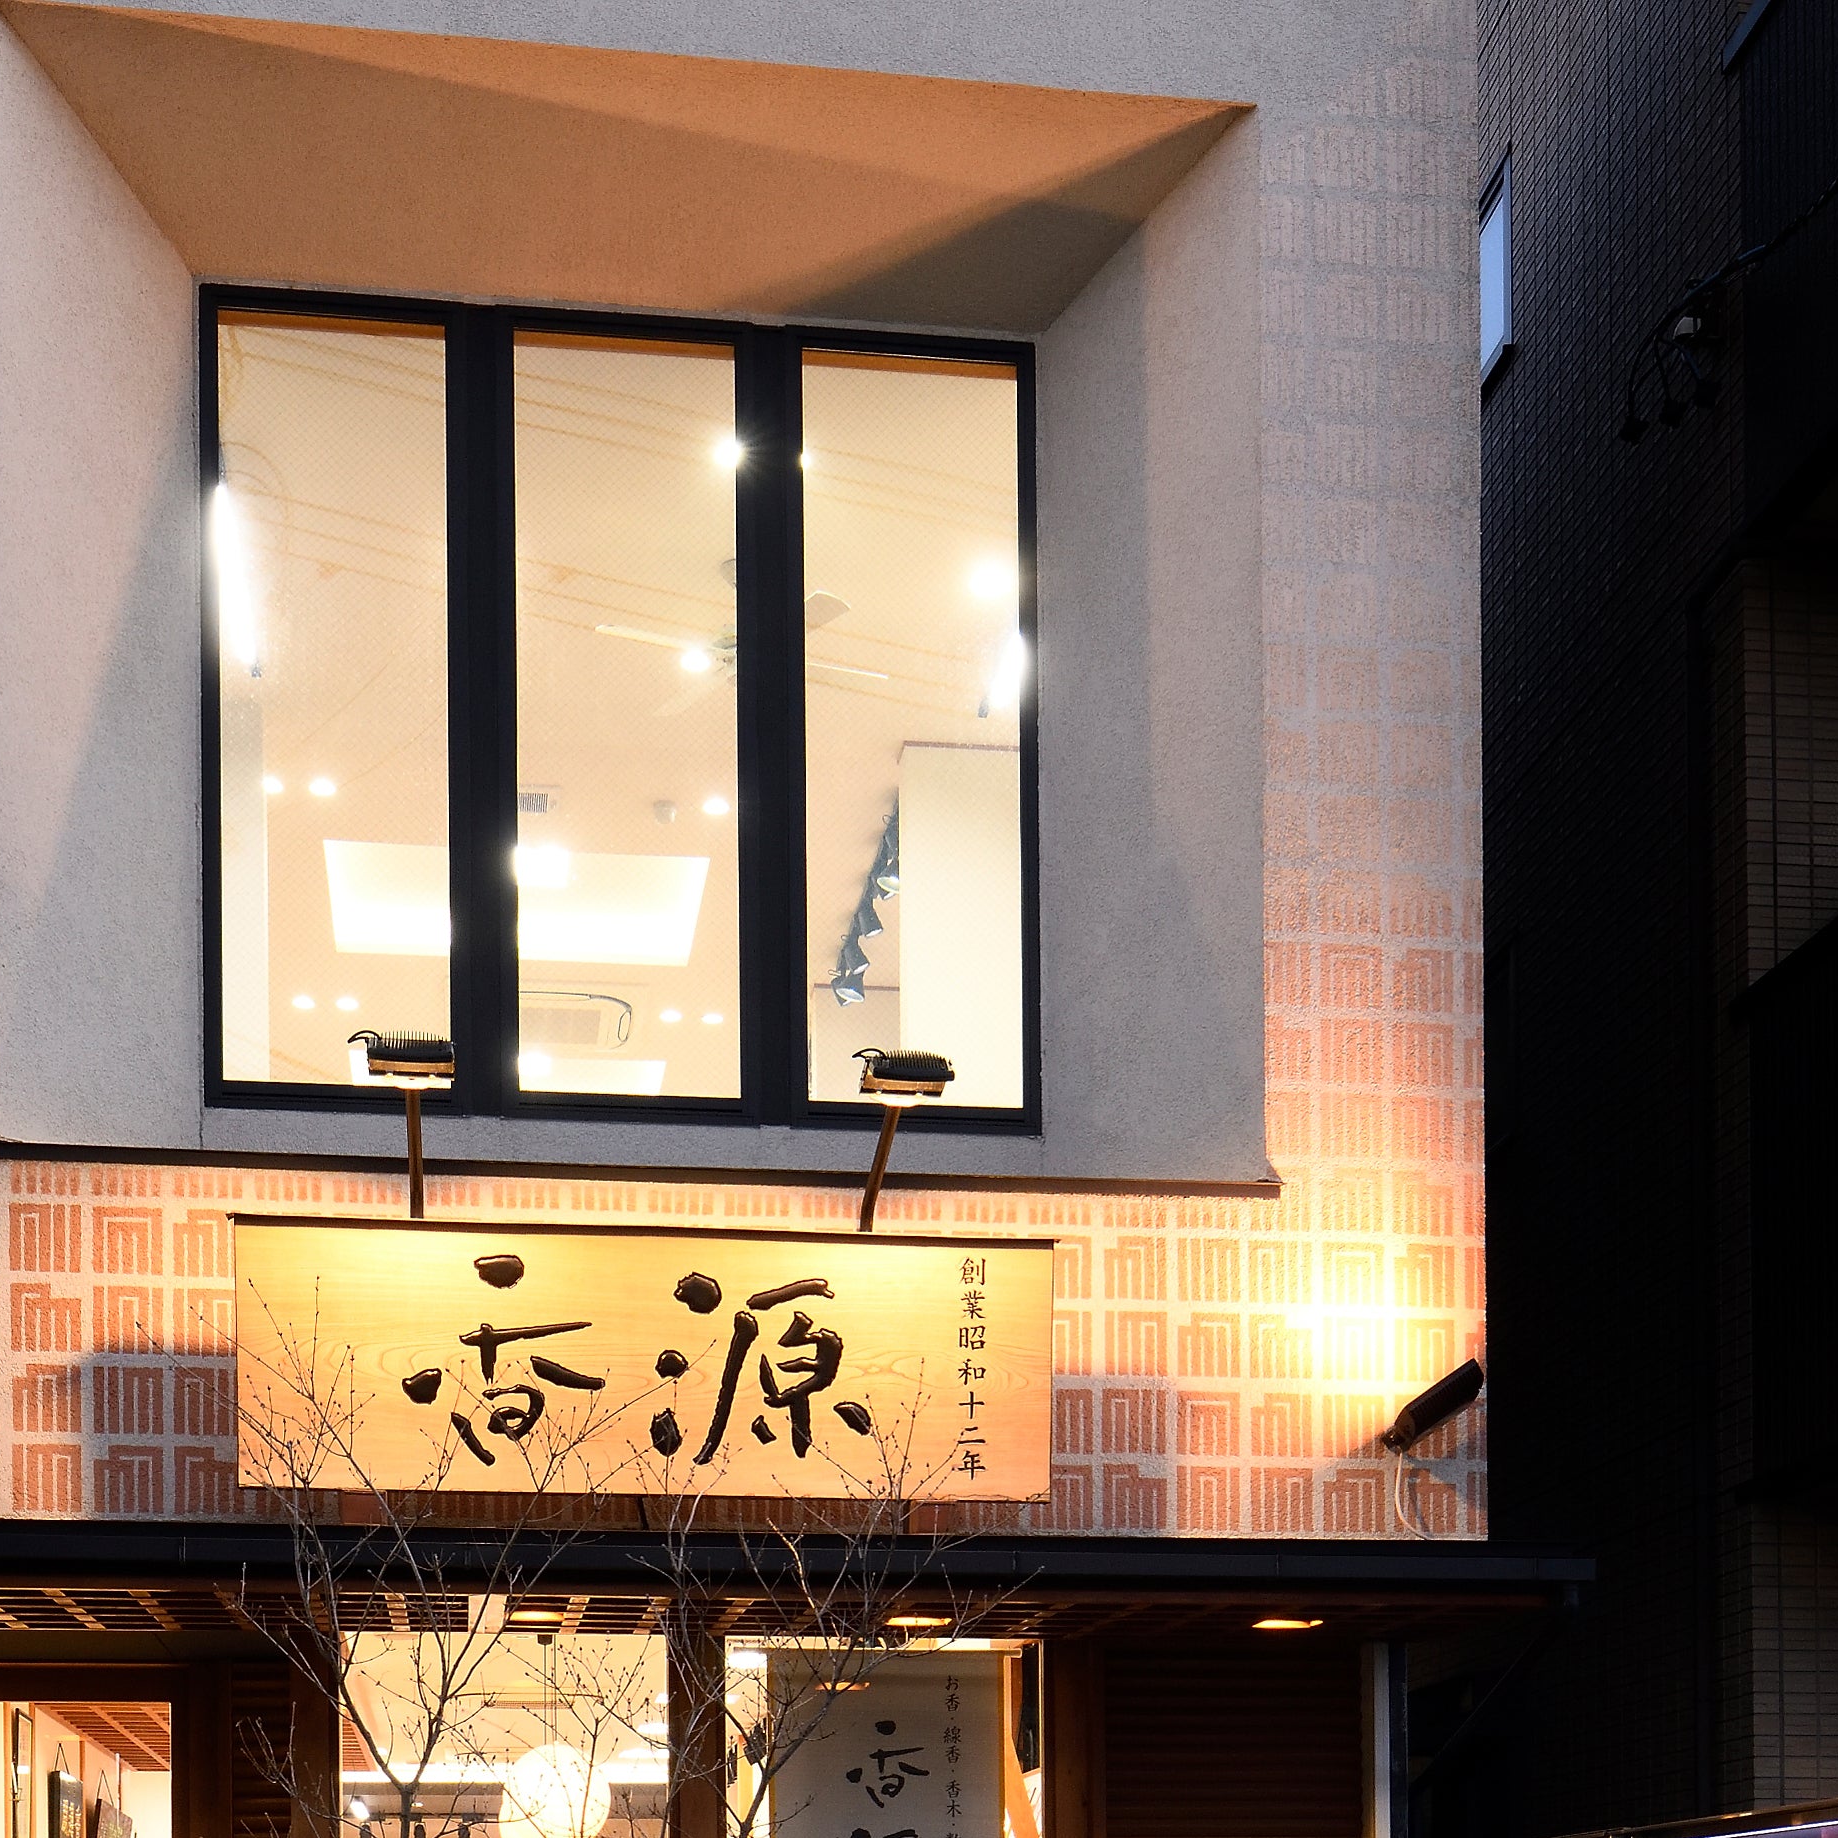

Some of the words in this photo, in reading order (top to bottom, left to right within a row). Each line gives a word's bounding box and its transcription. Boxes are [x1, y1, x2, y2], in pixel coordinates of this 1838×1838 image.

[402, 1254, 872, 1466] 香源
[958, 1256, 988, 1482] 創業昭和十二年
